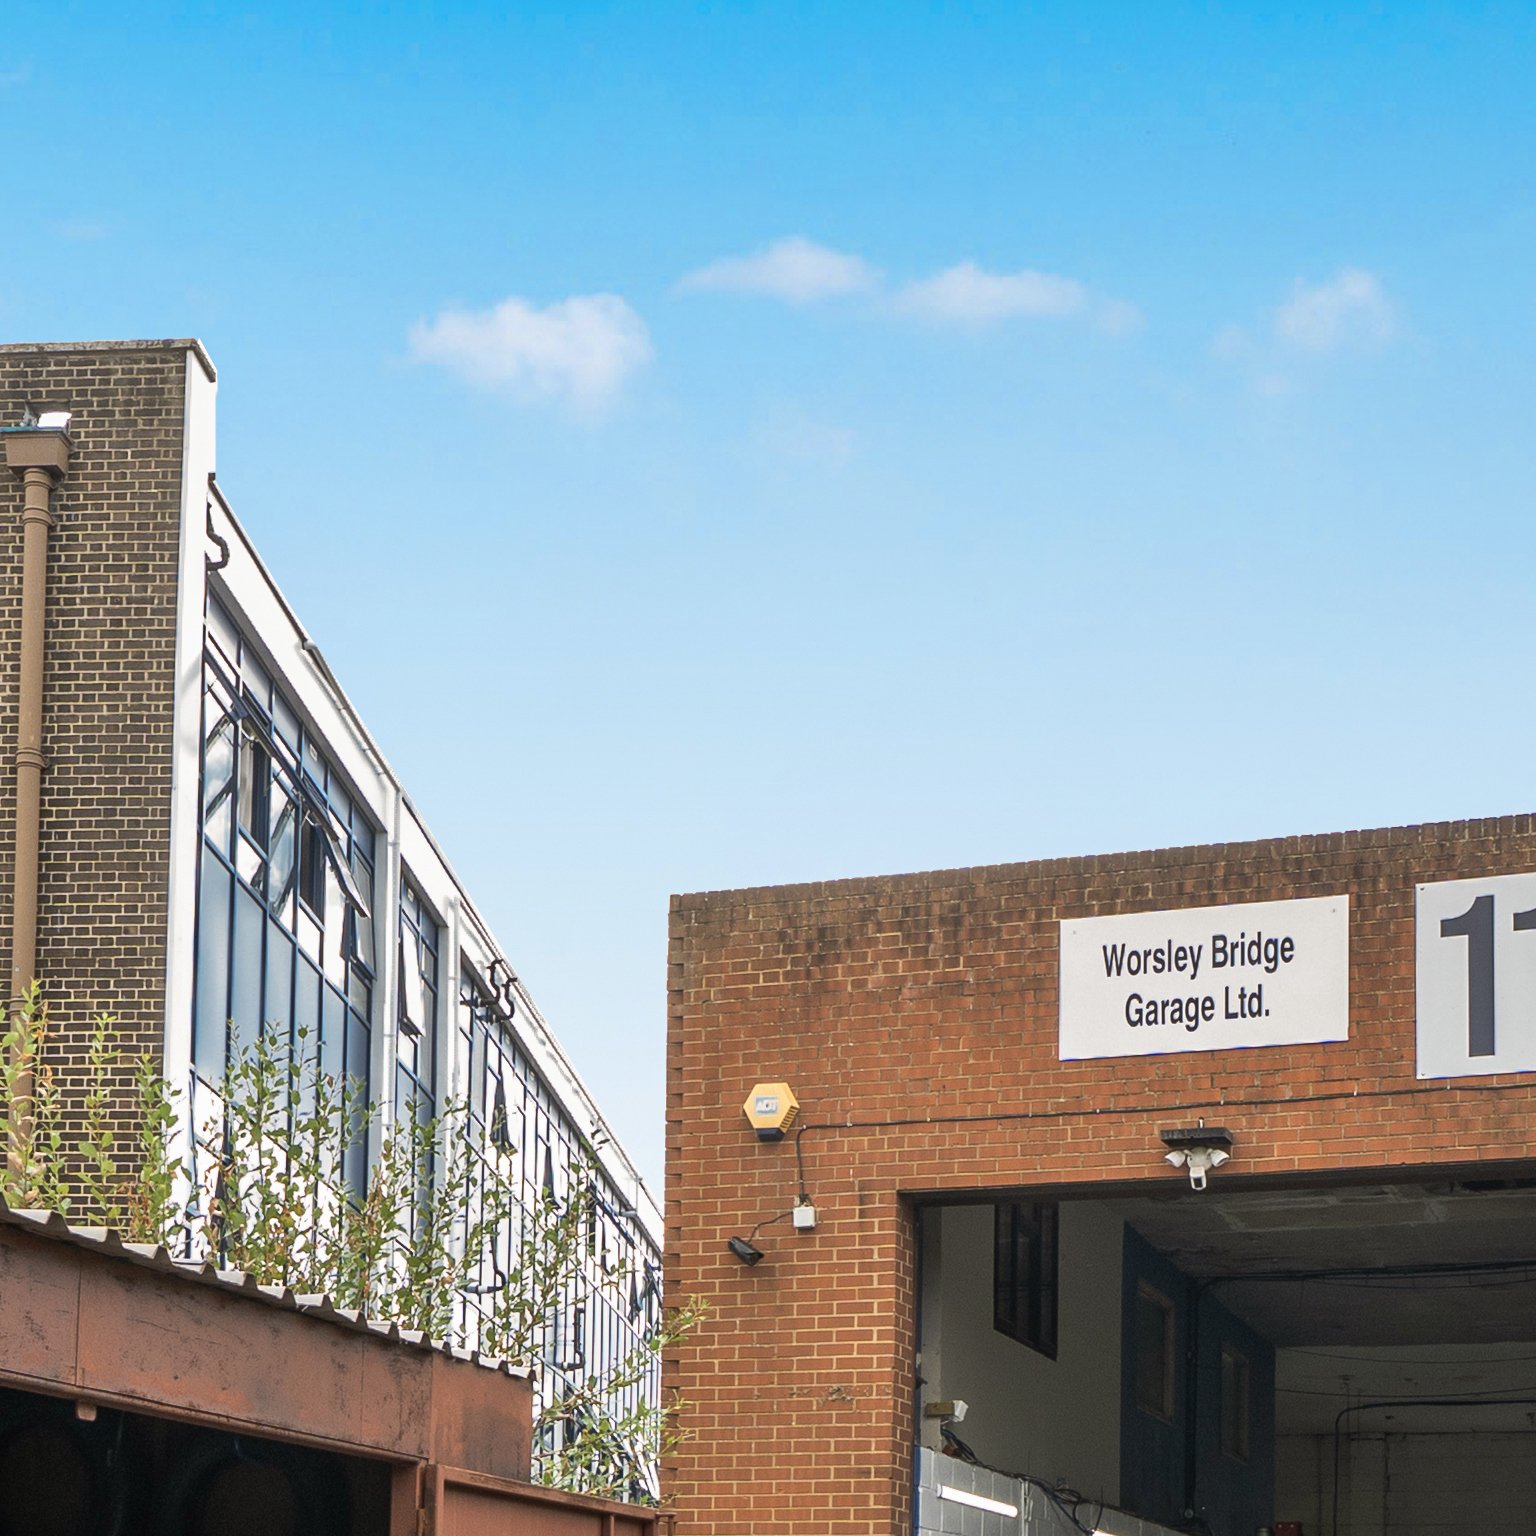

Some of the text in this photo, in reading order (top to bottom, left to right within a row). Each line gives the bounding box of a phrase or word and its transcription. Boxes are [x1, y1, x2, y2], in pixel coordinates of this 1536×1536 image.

[1103, 932, 1294, 980] Worsley Bridge
[1126, 984, 1269, 1032] Garage Ltd.
